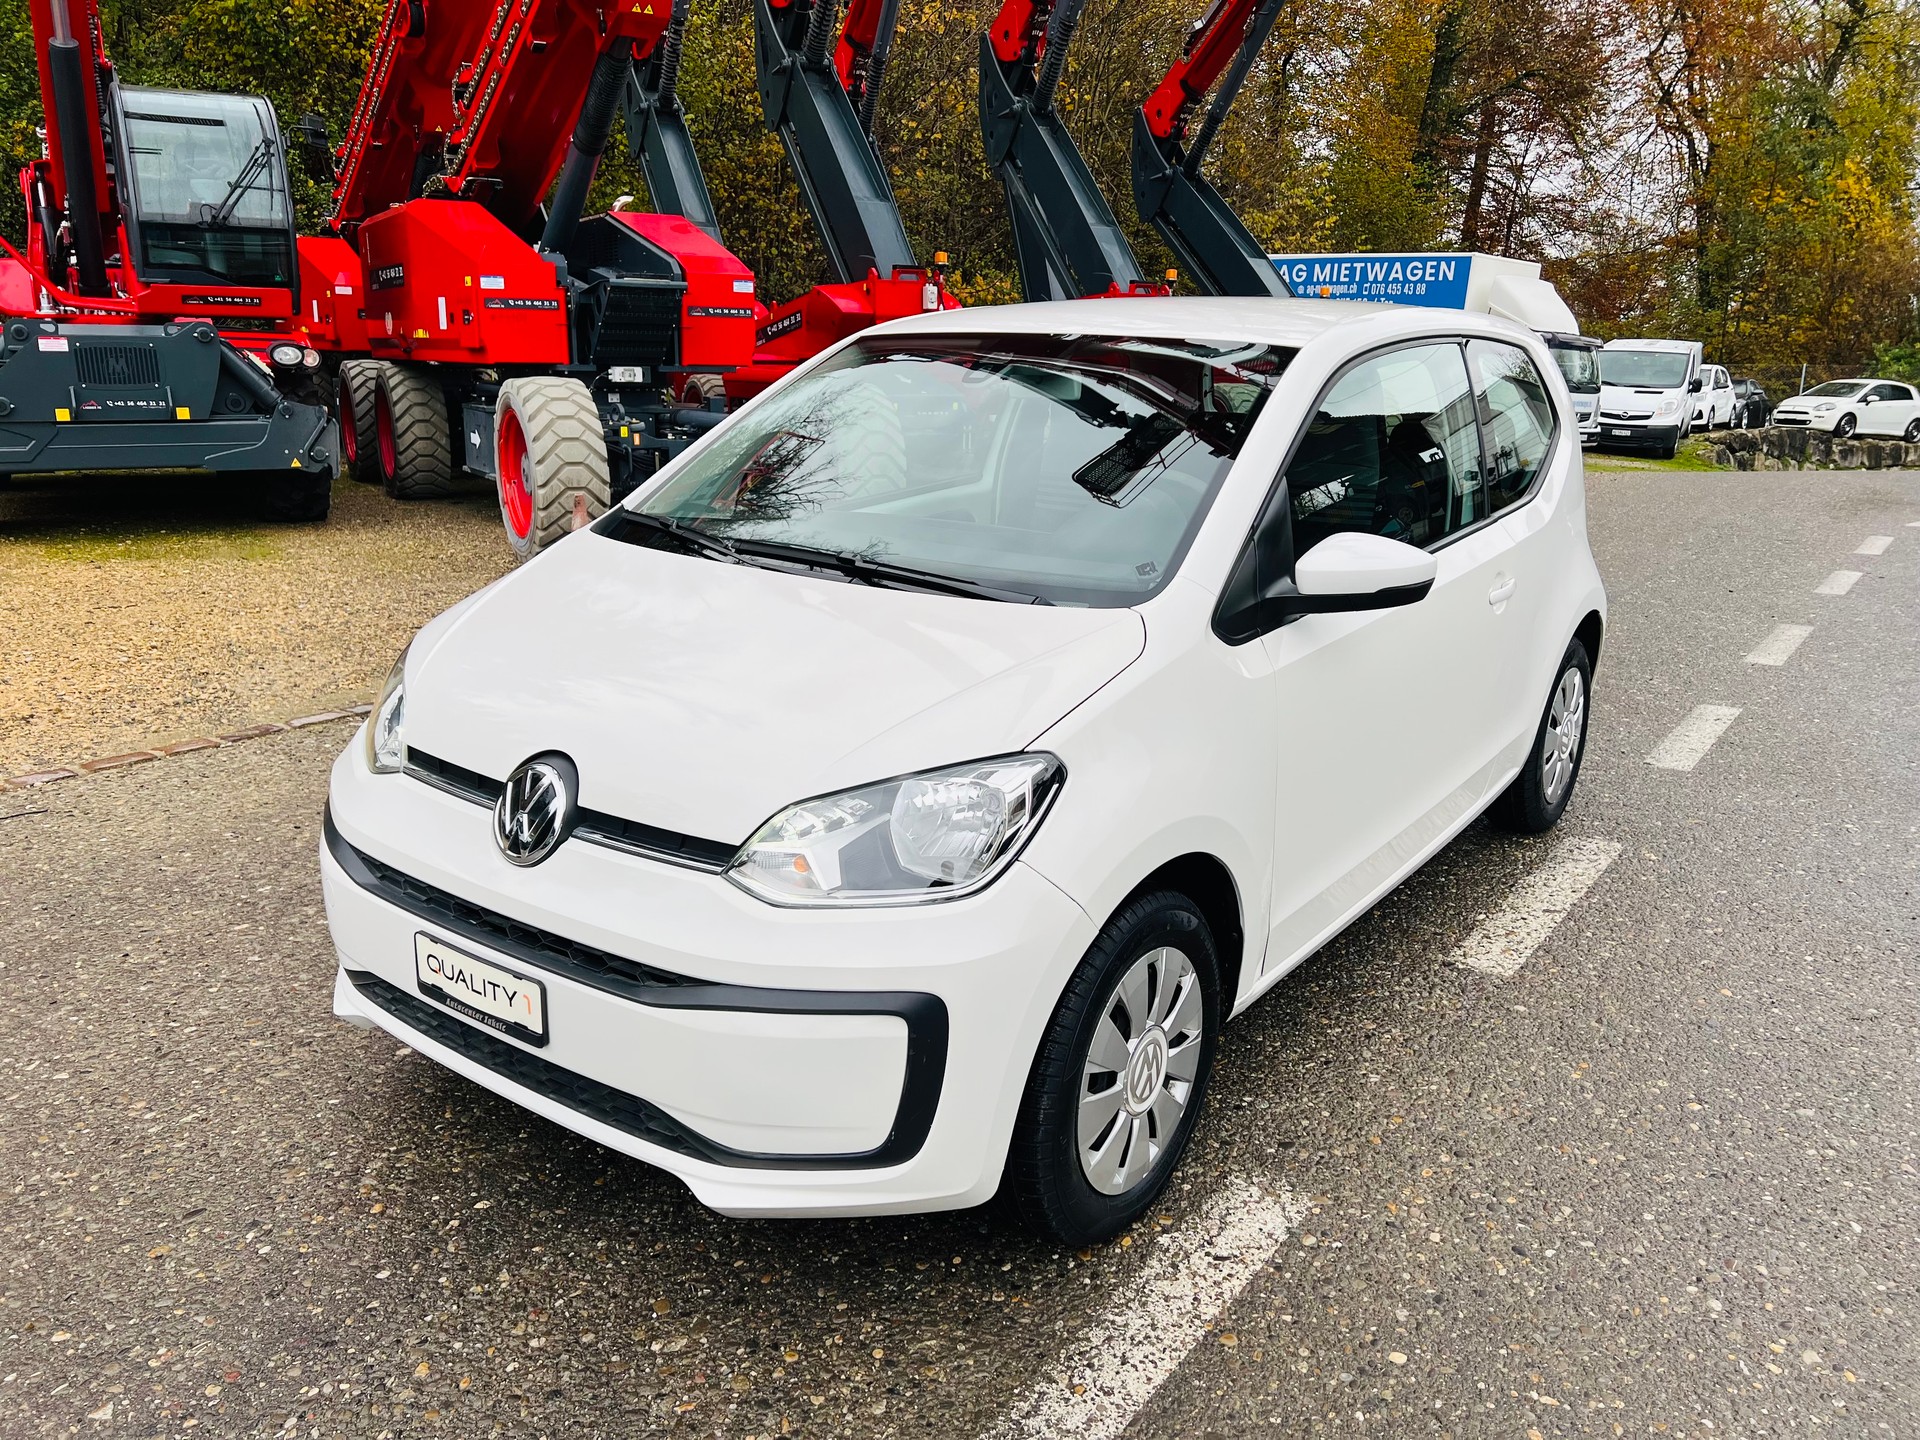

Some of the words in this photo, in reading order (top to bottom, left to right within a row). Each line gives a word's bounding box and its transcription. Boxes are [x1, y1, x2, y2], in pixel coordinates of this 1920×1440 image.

[1280, 264, 1307, 282] AG
[1313, 261, 1455, 282] MIETWAGEN
[1371, 284, 1385, 294] 076
[1387, 283, 1401, 294] 455
[1404, 283, 1413, 294] 43
[1416, 283, 1426, 294] 88
[494, 763, 566, 866] VW
[426, 954, 518, 1007] QUALITY
[523, 994, 531, 1015] 1
[446, 998, 483, 1020] Autocenter
[1129, 1038, 1164, 1104] VW
